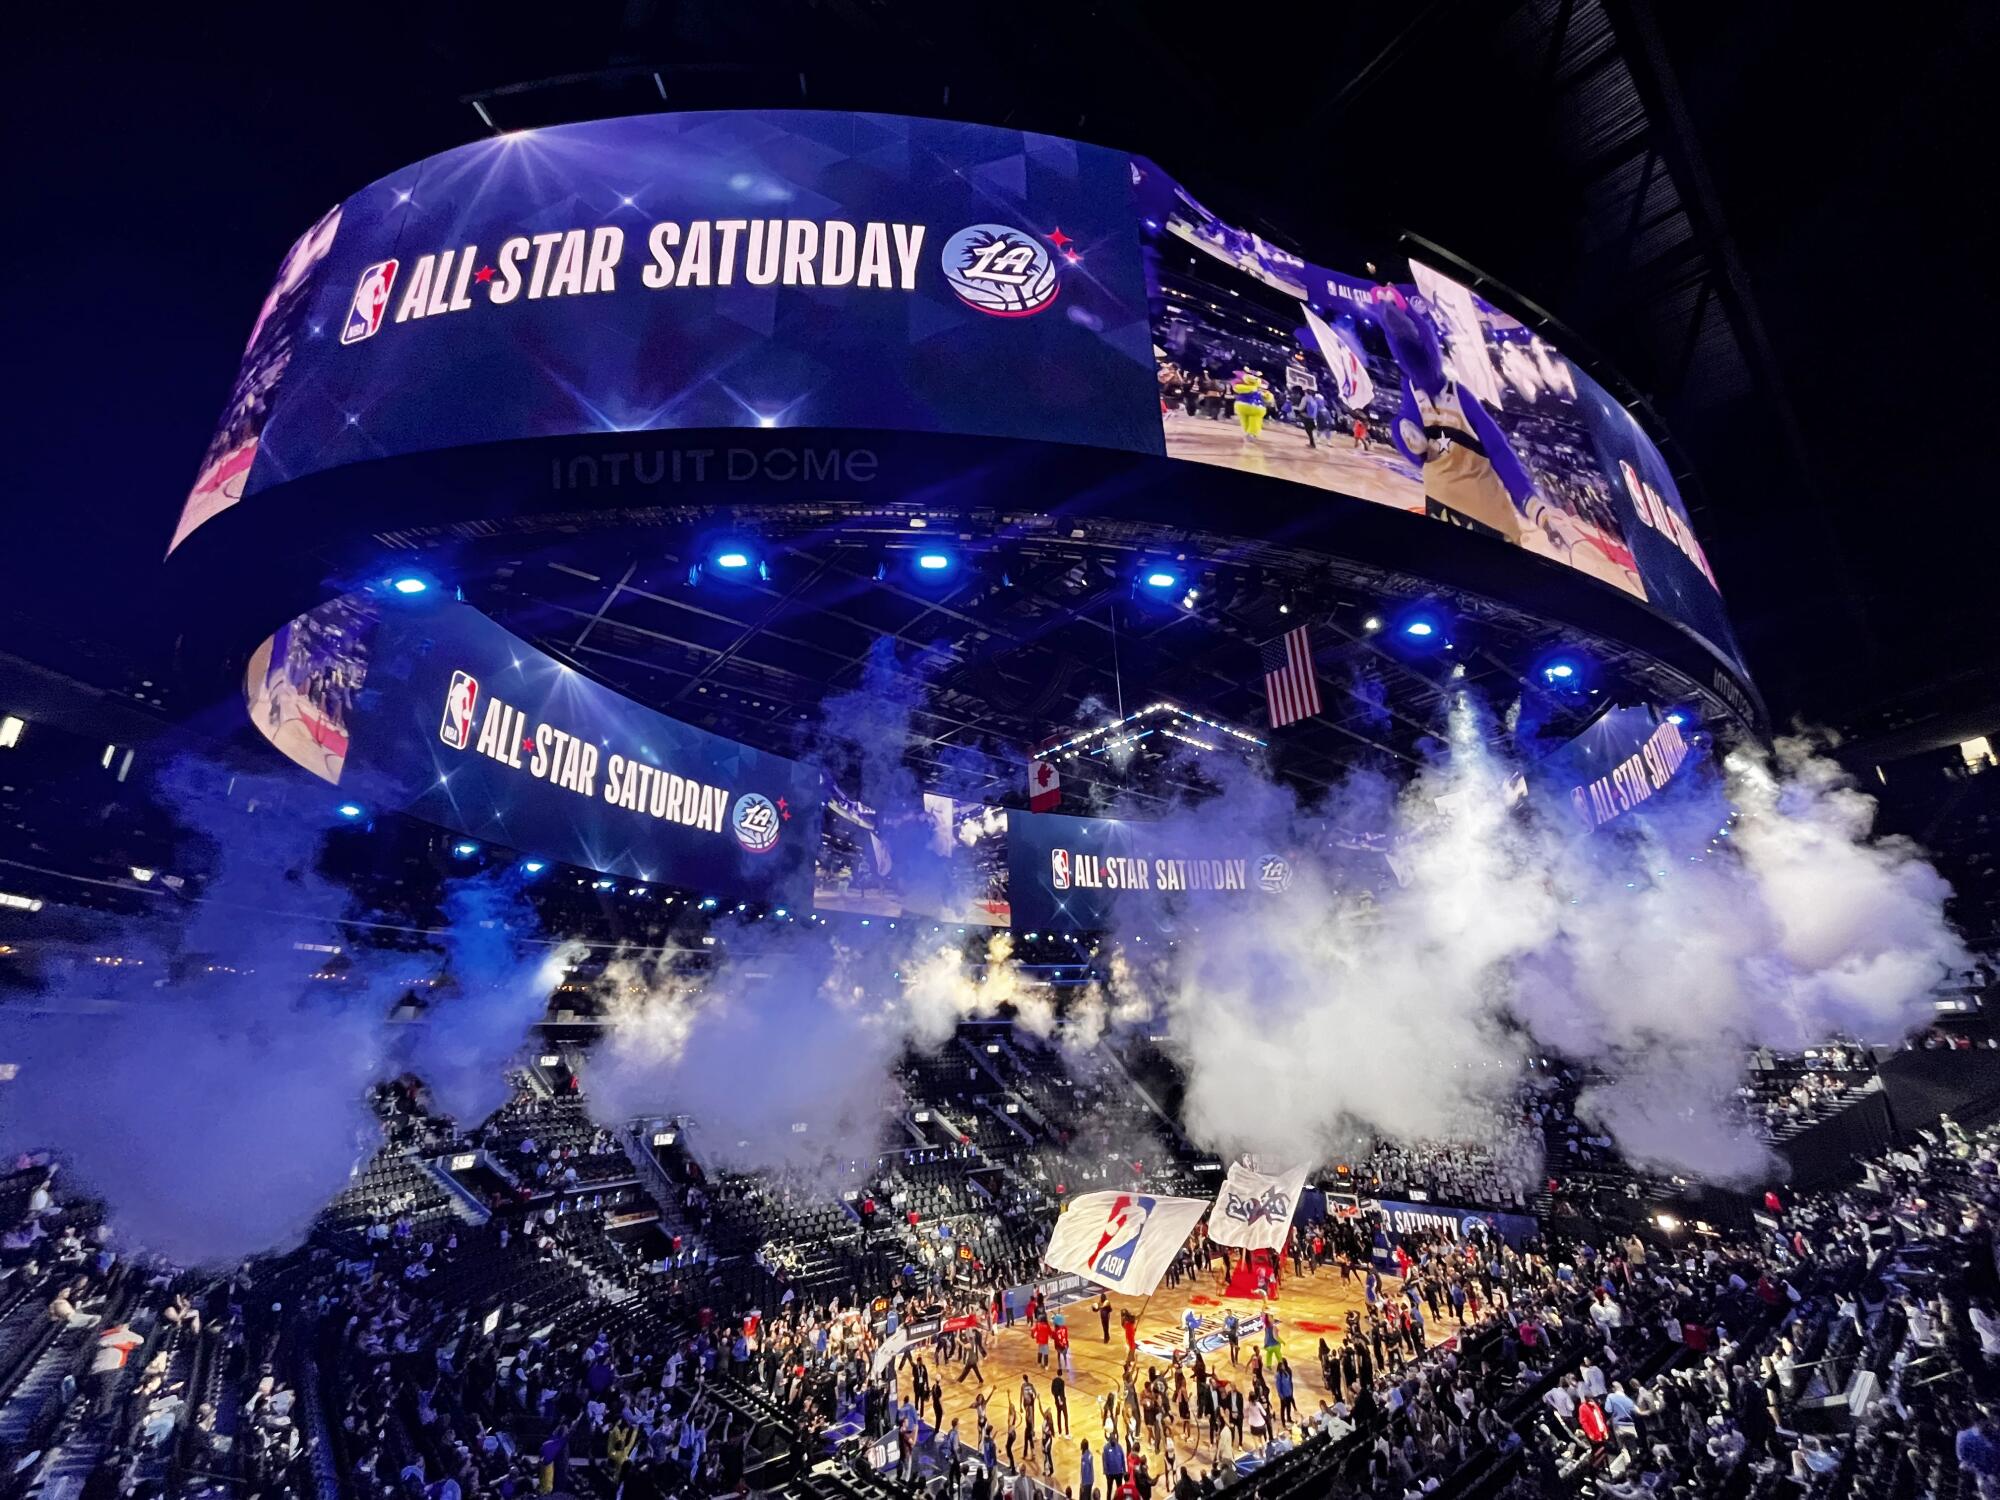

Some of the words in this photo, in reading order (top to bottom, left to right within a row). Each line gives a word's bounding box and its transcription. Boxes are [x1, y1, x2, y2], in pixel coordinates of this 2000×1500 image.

[395, 246, 477, 323] ALL
[489, 228, 624, 304] STAR
[642, 219, 926, 290] SATURDAY
[476, 697, 526, 769] ALL
[530, 723, 598, 797] STAR
[604, 754, 729, 833] SATURDAY
[1589, 776, 1620, 825] ALL
[1612, 753, 1651, 811] STAR
[1075, 854, 1102, 888] ALL
[1106, 856, 1149, 890] STAR
[1155, 858, 1246, 891] SATURDAY
